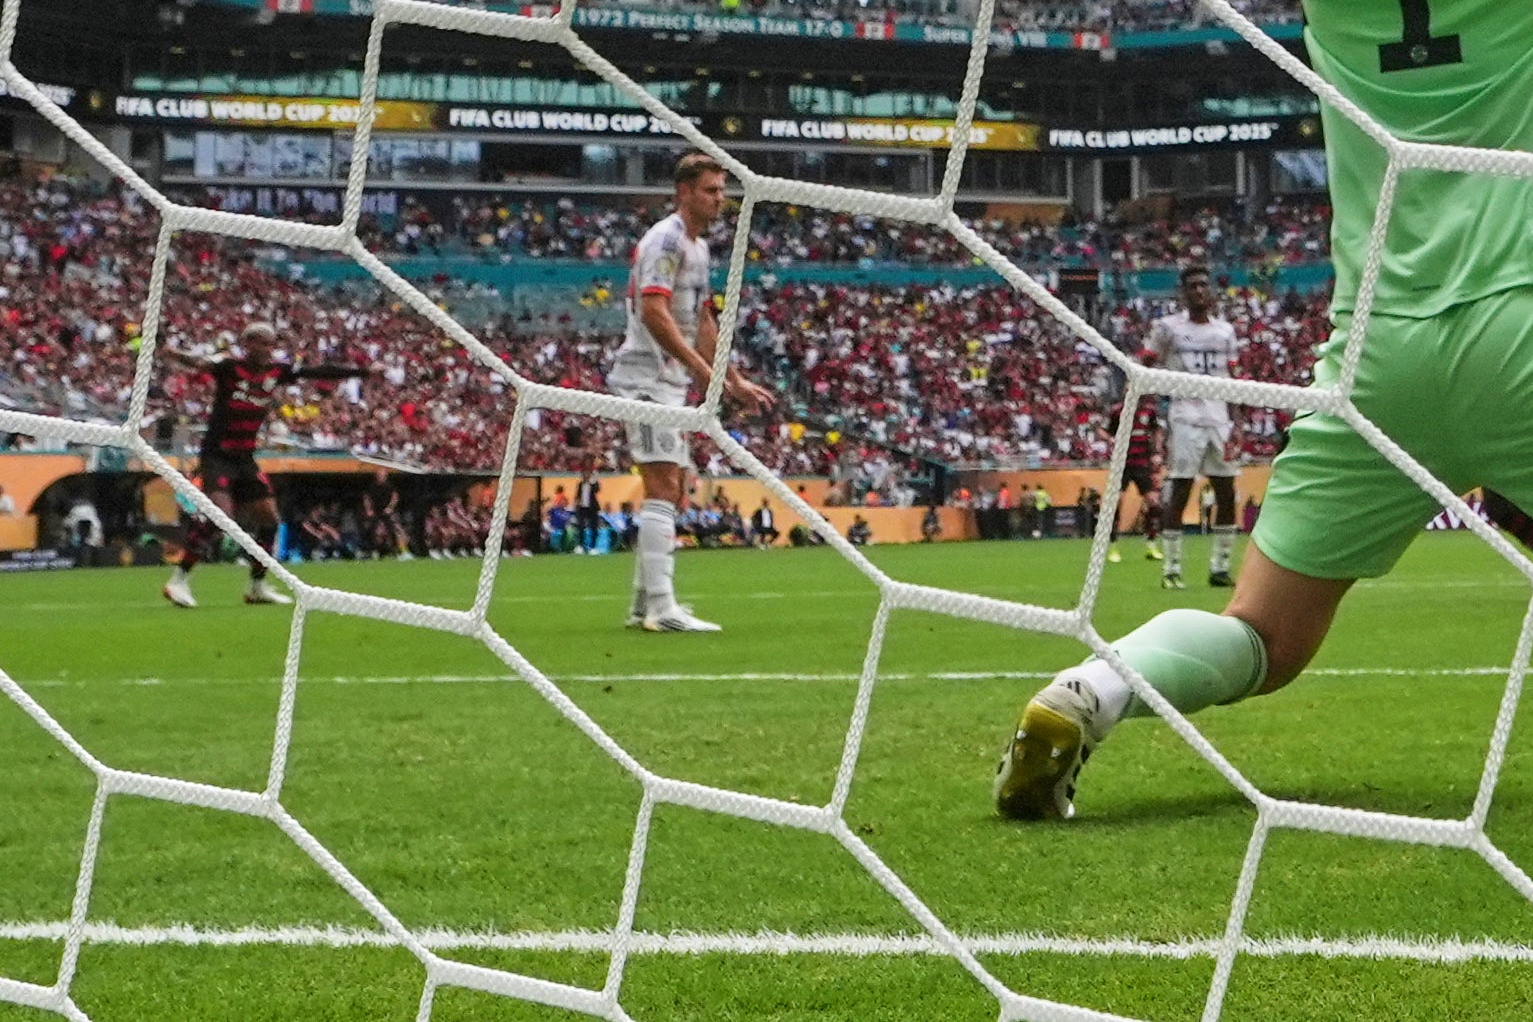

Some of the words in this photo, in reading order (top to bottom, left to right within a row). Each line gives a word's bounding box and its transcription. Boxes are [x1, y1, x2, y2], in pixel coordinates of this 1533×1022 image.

[114, 95, 156, 116] FIFA
[156, 98, 209, 119] CLUB
[211, 100, 283, 121] WORLD
[285, 102, 325, 122] CUP
[328, 104, 374, 124] 202
[450, 108, 490, 128] FIFA
[491, 109, 541, 129] CLUB
[542, 111, 609, 132] WORLD
[610, 114, 648, 134] CUP
[761, 118, 800, 138] FIFA
[800, 120, 846, 140] CLUB
[846, 121, 908, 142] WORLD
[909, 124, 945, 142] CUP
[1049, 129, 1085, 147] FIFA
[1085, 129, 1131, 148] CLUB
[1131, 127, 1192, 147] WORLD
[1193, 124, 1228, 143] CUP
